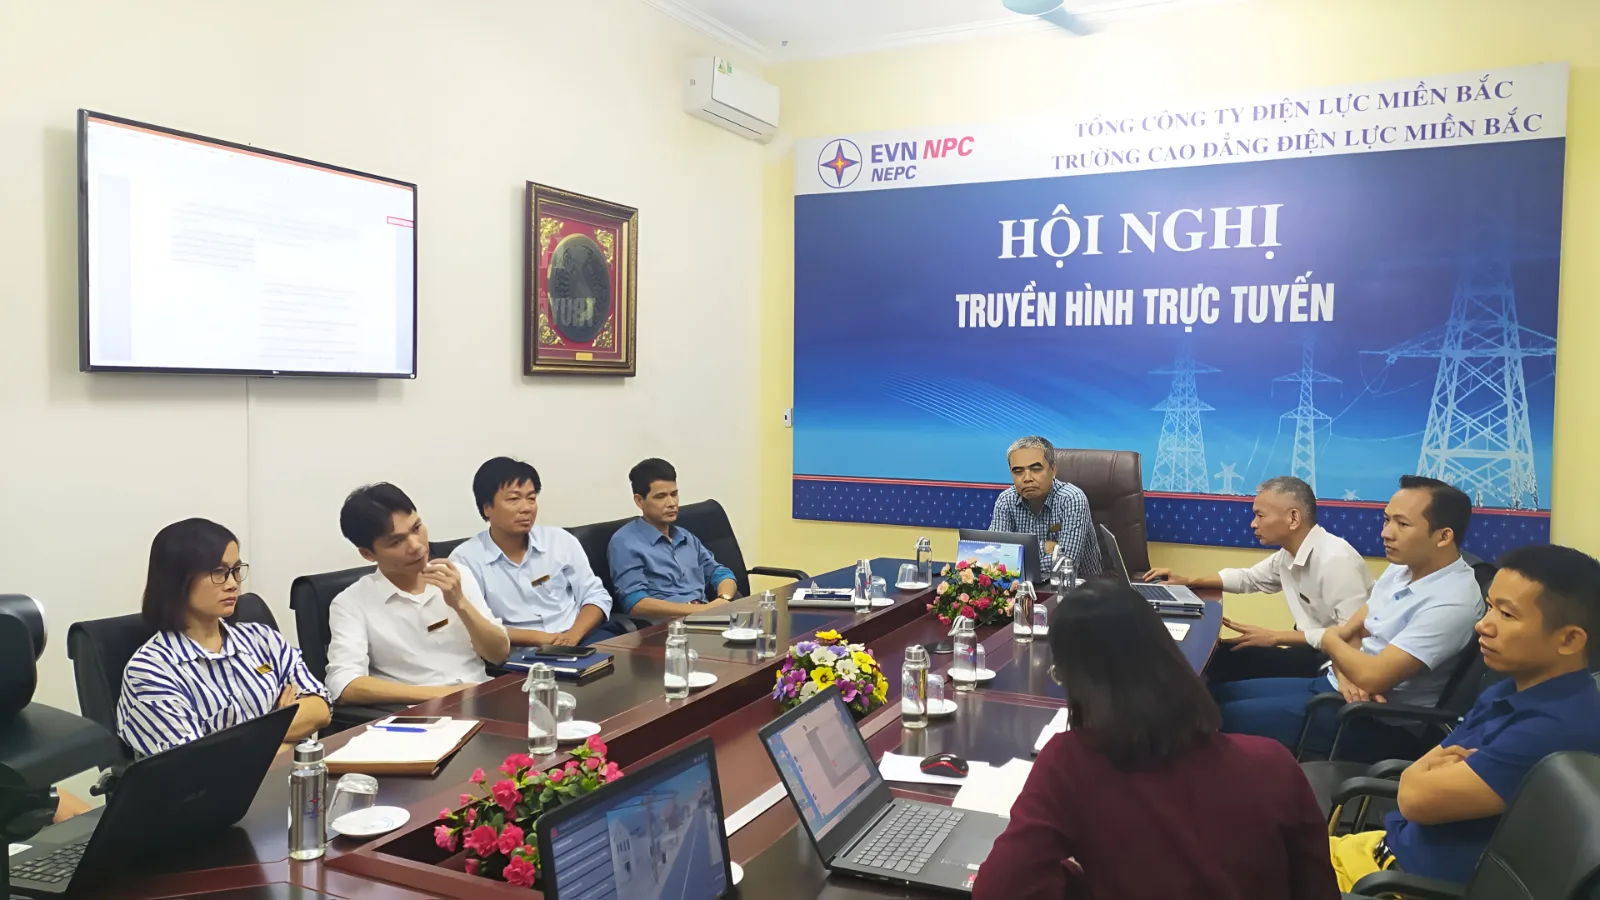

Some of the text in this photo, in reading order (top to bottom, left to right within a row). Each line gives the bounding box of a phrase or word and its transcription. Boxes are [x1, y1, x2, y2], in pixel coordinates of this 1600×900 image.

[1074, 73, 1514, 139] TỔNG CÔNG TY ĐIỆN LỰC MIỀN BẮC
[871, 136, 975, 164] EVN NPC
[1051, 106, 1543, 170] TRƯỜNG CAO ĐẲNG ĐIỆN LỰC MIỀN BẮC
[871, 165, 917, 182] NEPC
[997, 203, 1285, 268] HỘI NGHỊ
[956, 270, 1335, 333] TRUYỀN HÌNH TRỰC TUYẾN
